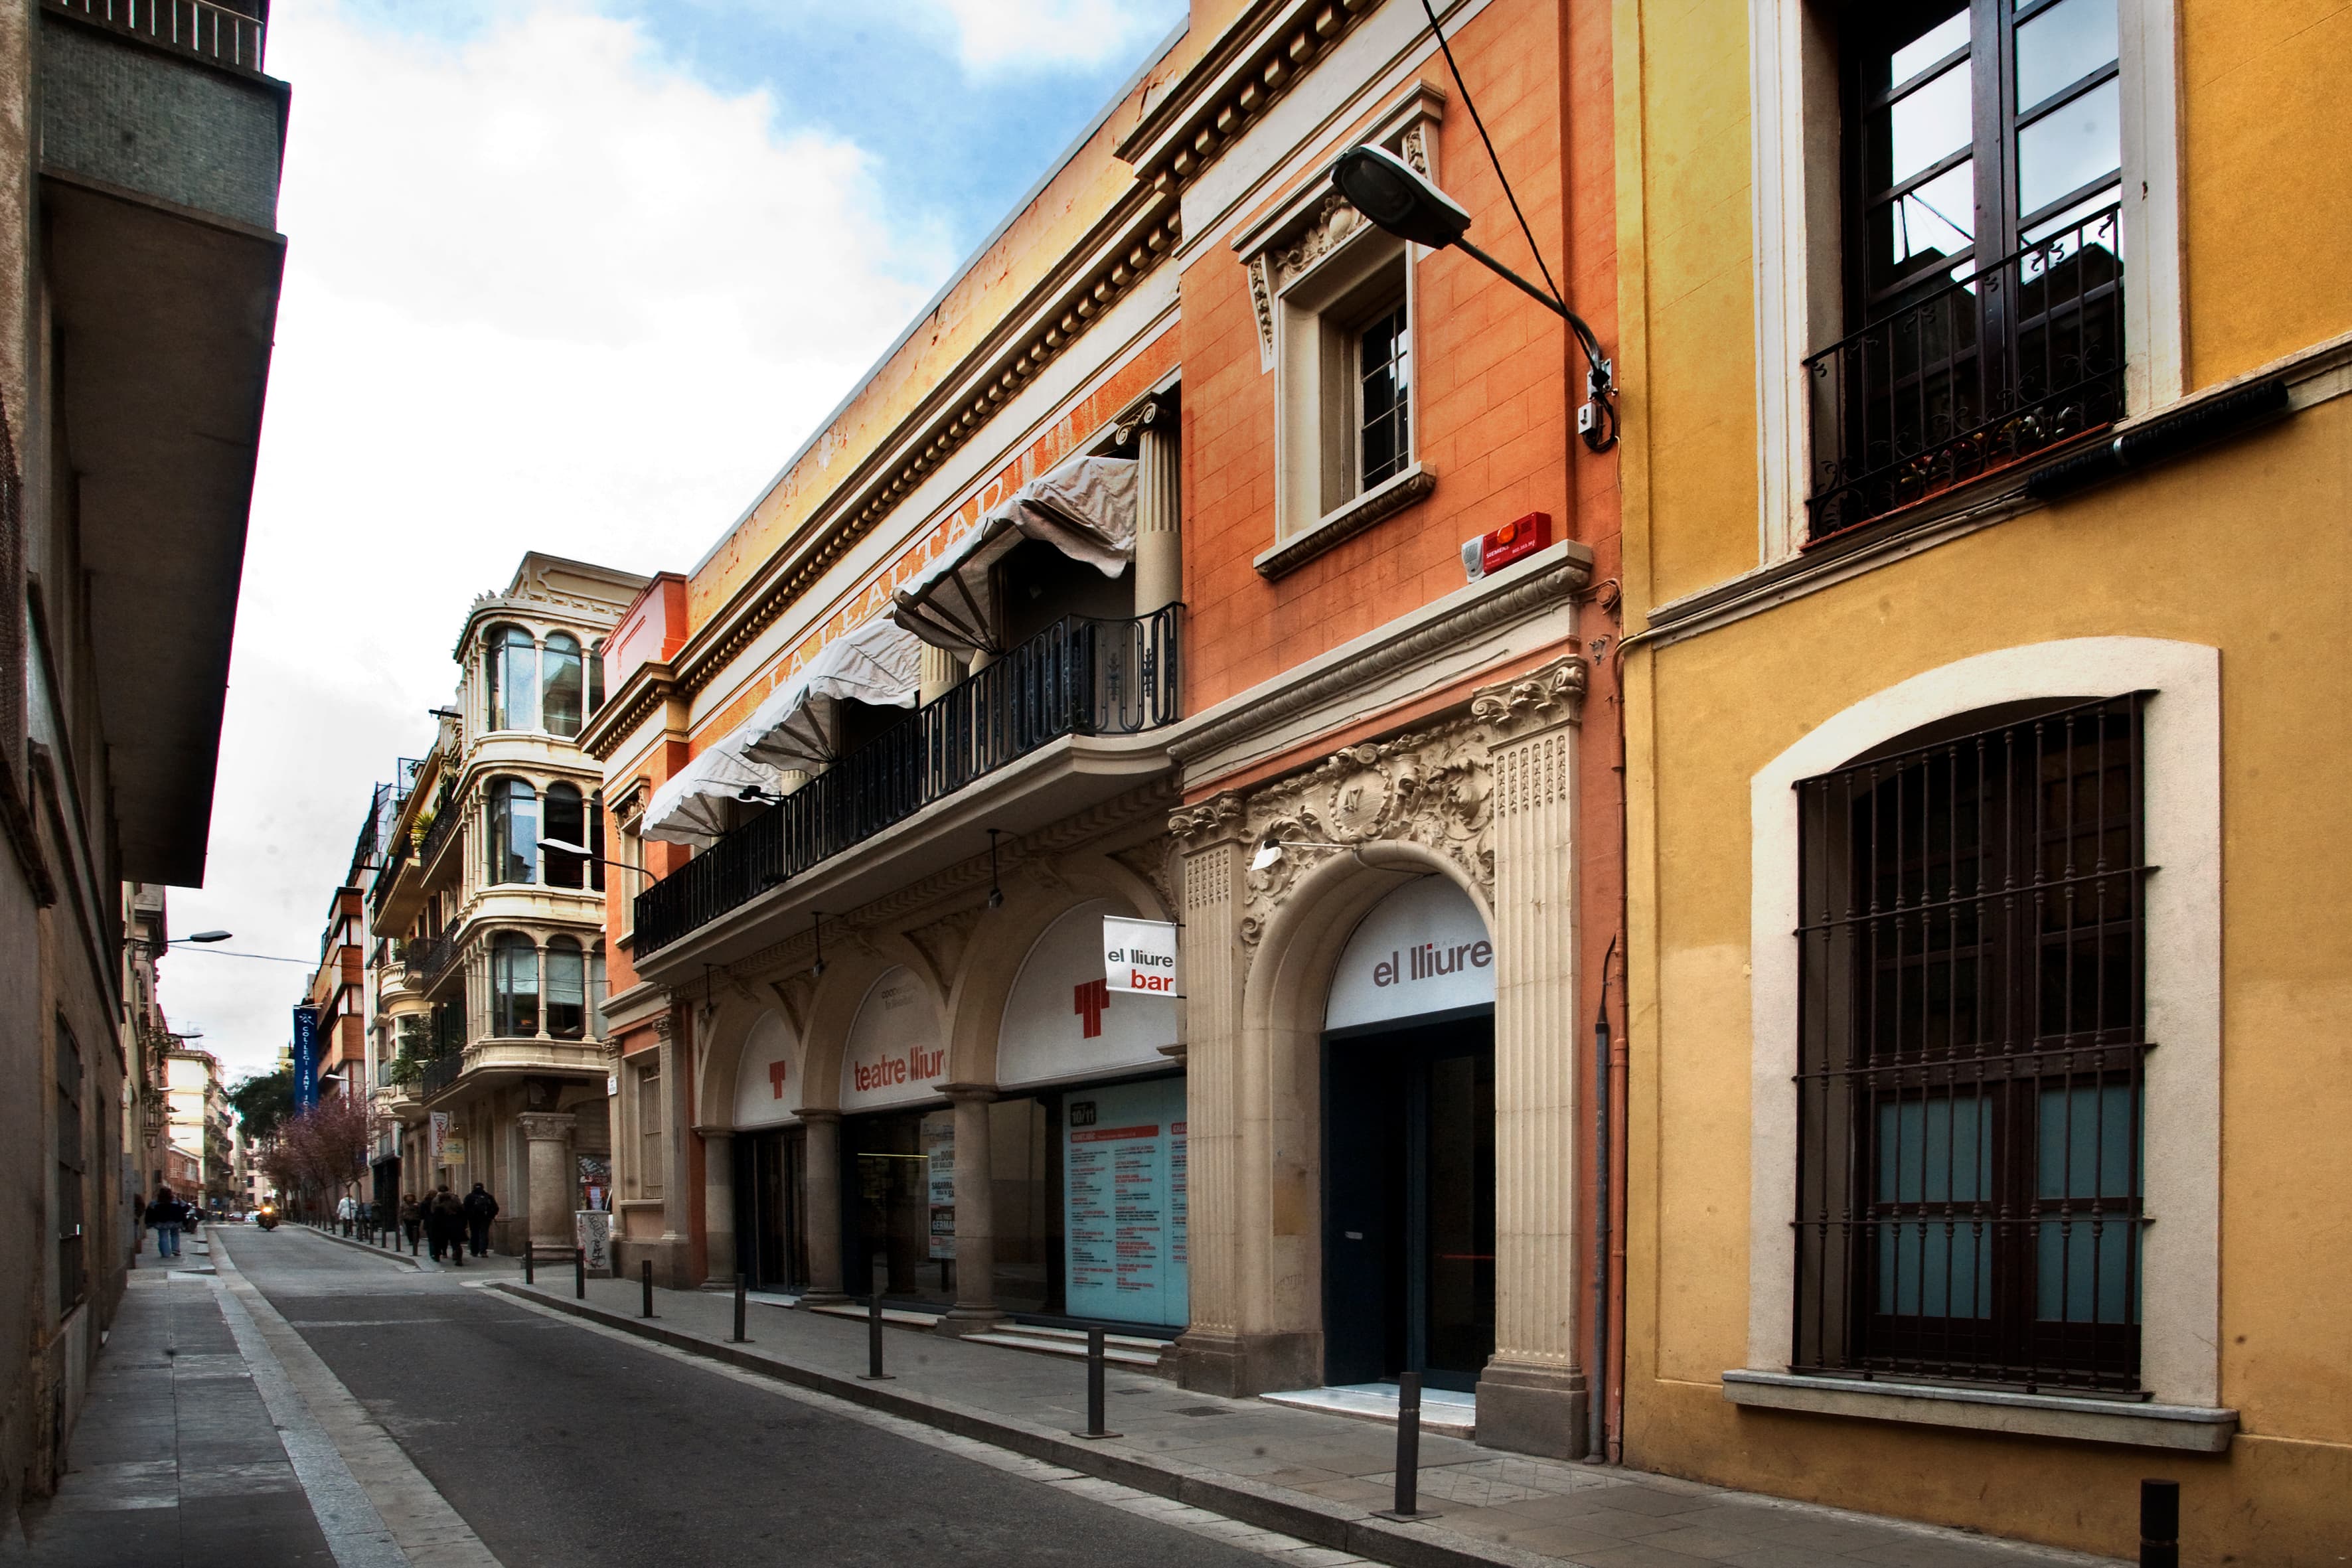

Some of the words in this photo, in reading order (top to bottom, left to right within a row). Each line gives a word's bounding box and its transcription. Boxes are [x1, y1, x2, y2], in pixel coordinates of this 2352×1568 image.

[1108, 947, 1125, 963] el
[1131, 948, 1174, 968] lliure
[1373, 950, 1399, 988] el
[1411, 940, 1492, 981] lliure
[1131, 968, 1174, 992] bar
[854, 1054, 906, 1092] teatre
[1072, 1109, 1095, 1123] 10/11
